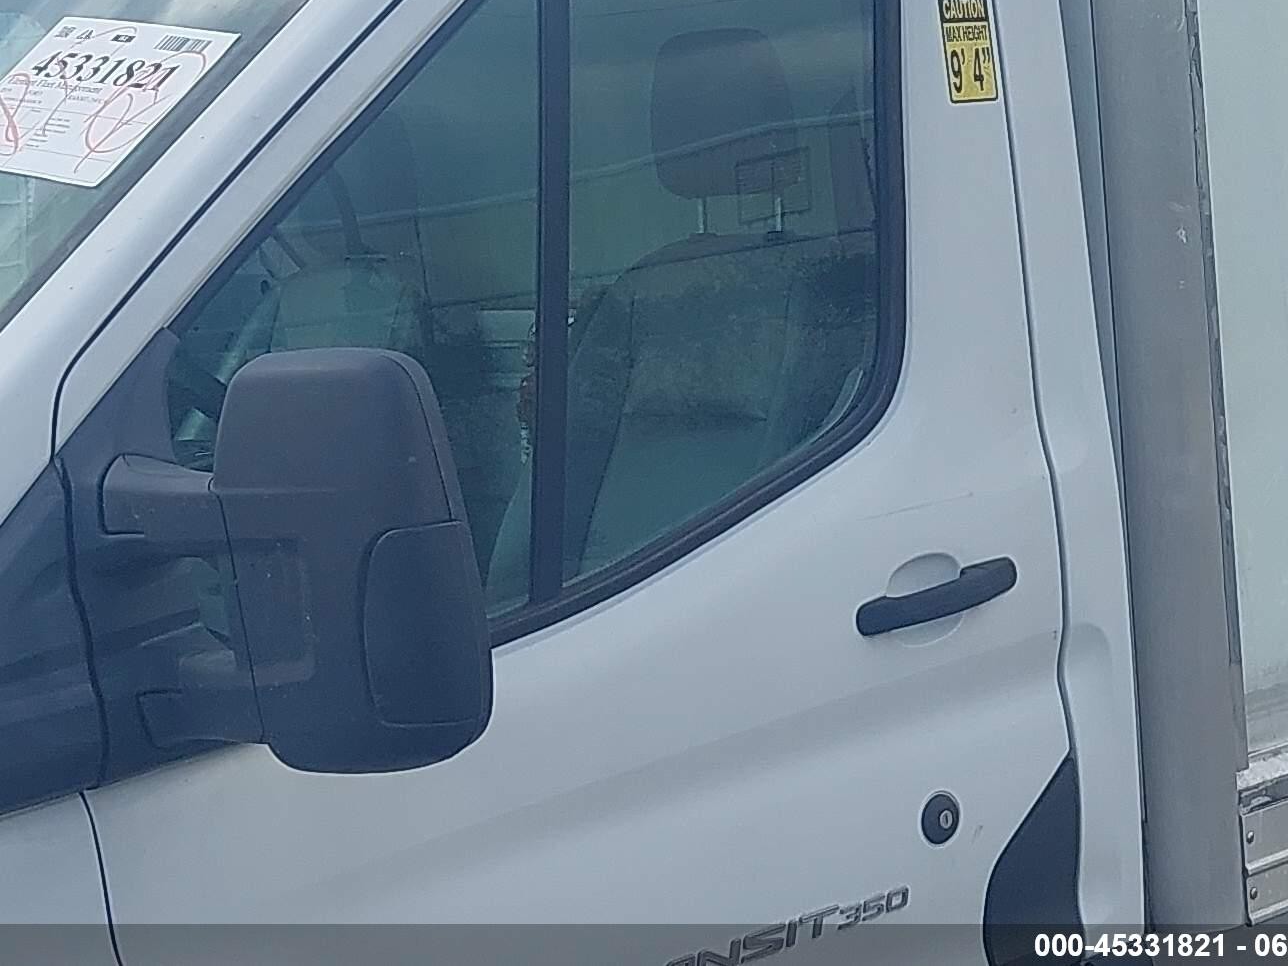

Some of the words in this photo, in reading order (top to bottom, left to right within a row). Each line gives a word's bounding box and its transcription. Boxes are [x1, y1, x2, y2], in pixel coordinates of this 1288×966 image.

[945, 25, 963, 43] MAX
[962, 24, 988, 42] HEIGHT
[31, 51, 181, 91] 45331821
[950, 47, 966, 94] 9'
